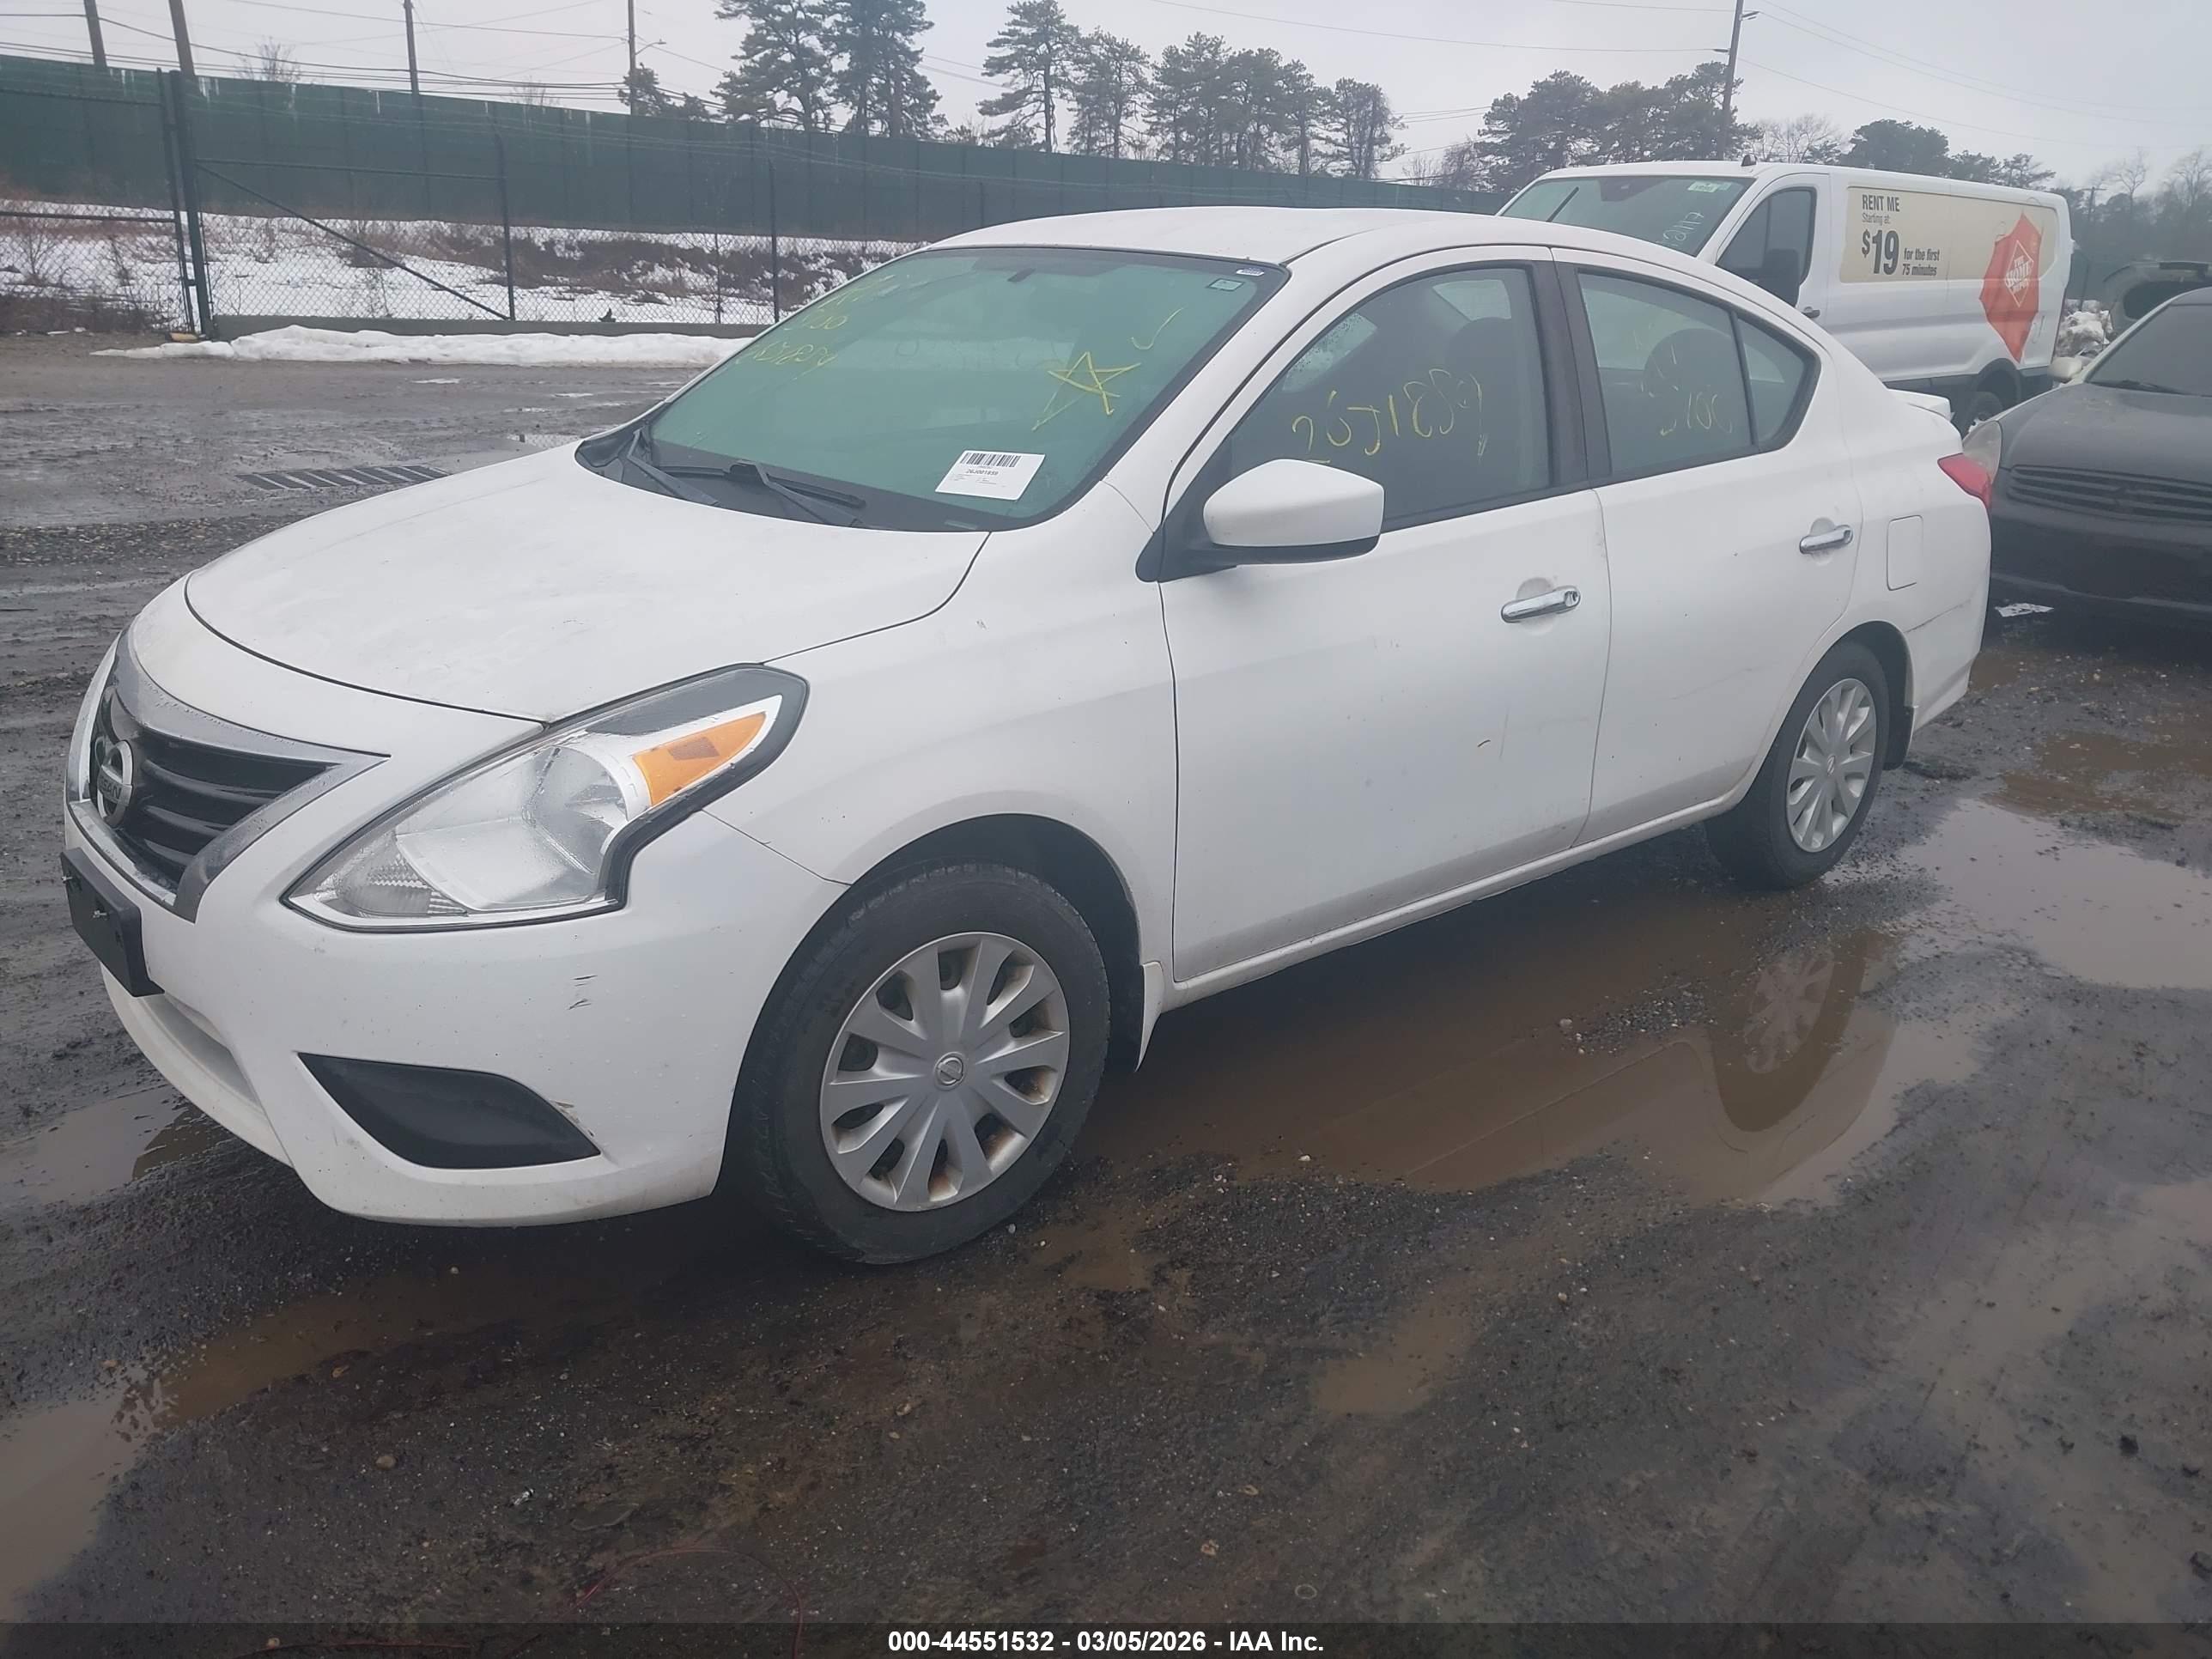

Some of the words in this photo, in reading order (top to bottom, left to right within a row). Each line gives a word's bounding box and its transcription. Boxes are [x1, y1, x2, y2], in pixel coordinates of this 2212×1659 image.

[1862, 194, 1884, 211] RENT
[1887, 196, 1900, 212] ME
[1862, 212, 1883, 226] Starting
[1904, 247, 1914, 260] for
[1915, 248, 1926, 261] the
[1926, 248, 1941, 261] first
[1902, 263, 1911, 276] 75
[1911, 263, 1938, 276] minutes
[2005, 260, 2033, 288] HOME
